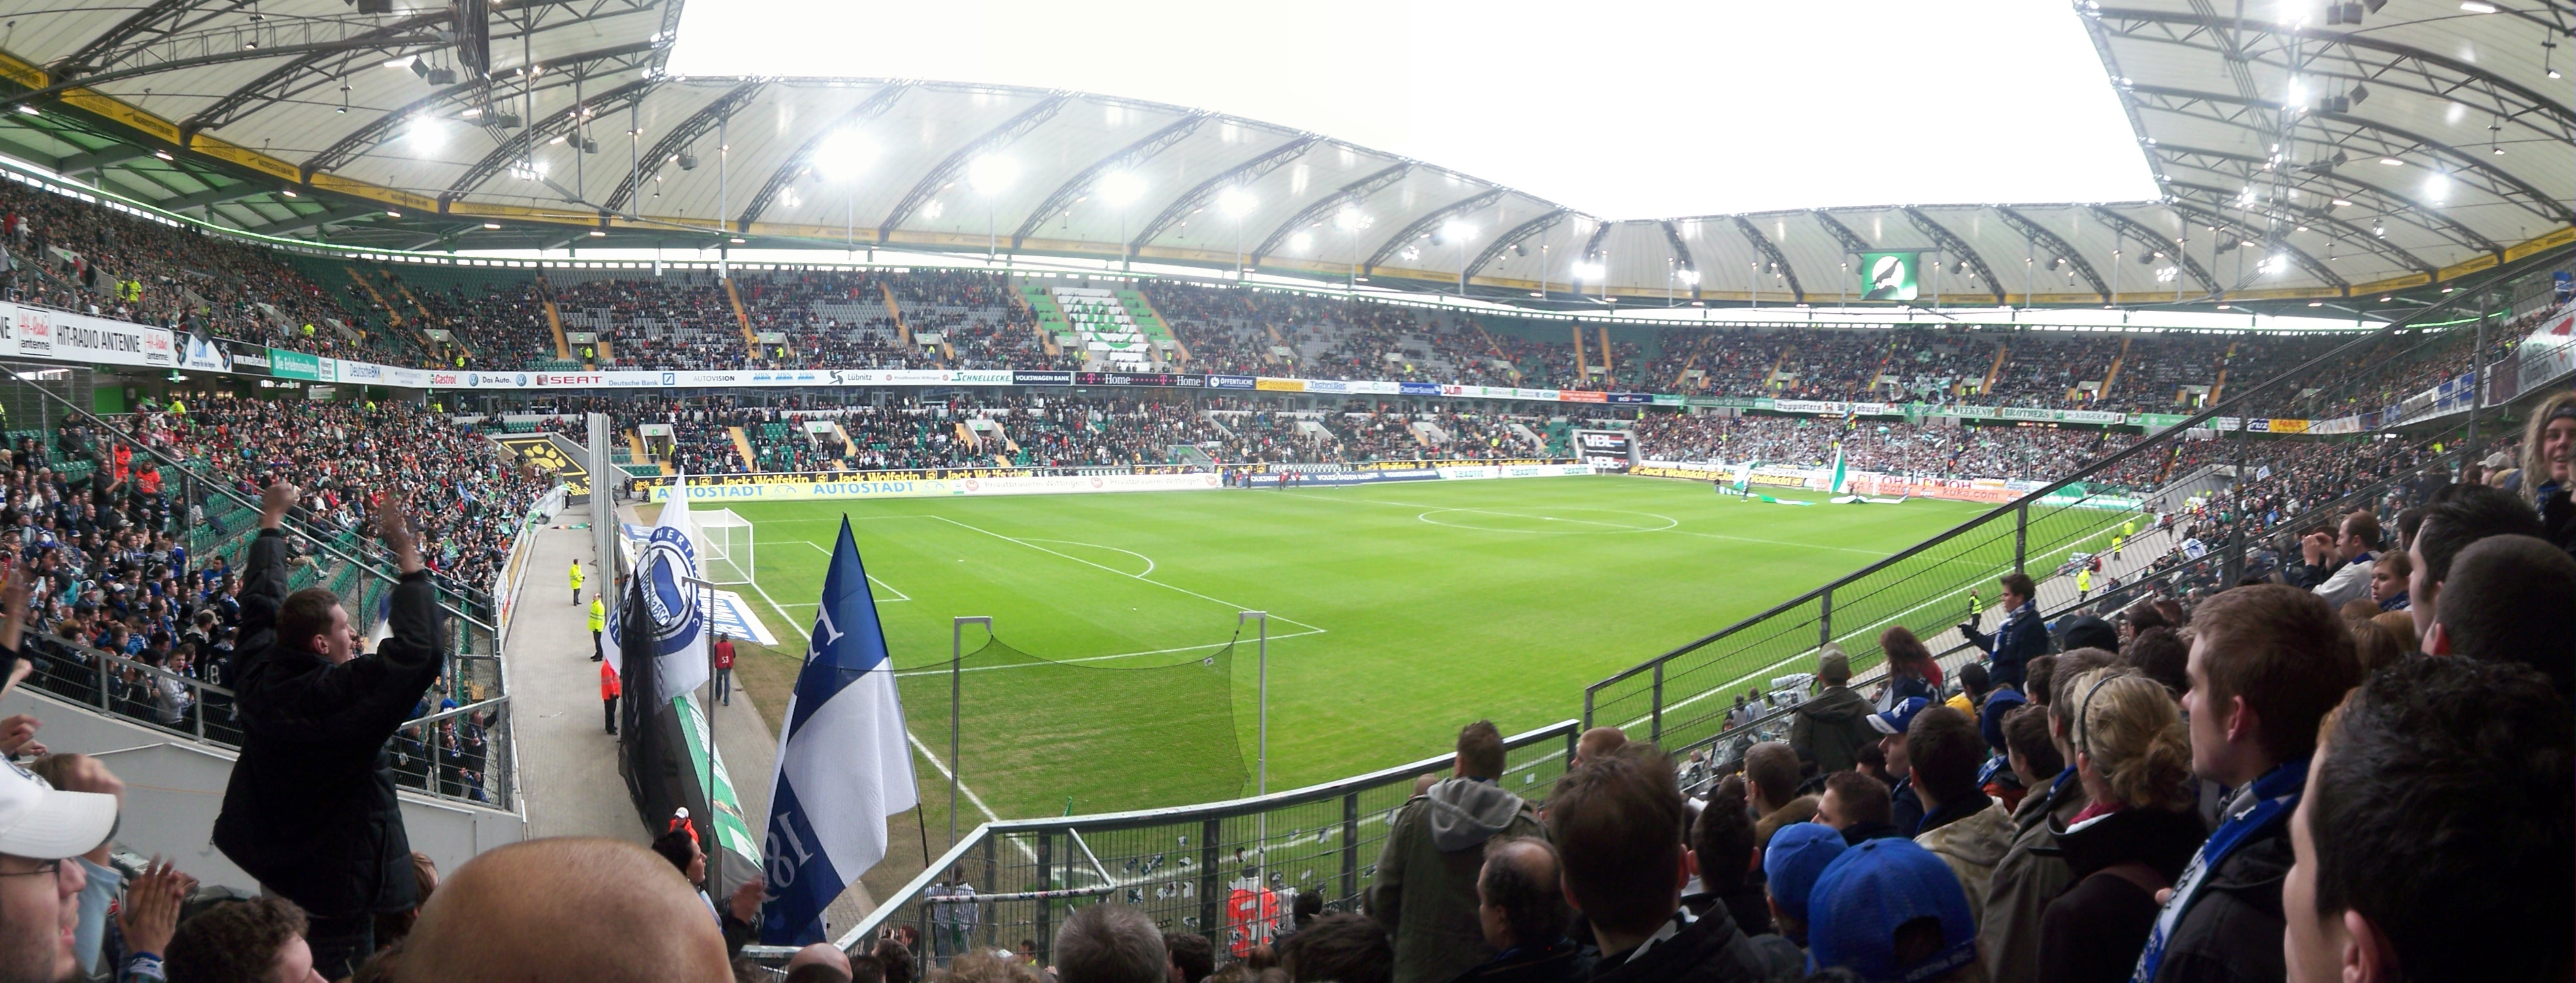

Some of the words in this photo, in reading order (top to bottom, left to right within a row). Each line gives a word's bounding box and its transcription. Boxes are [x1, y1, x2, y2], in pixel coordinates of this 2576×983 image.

[56, 324, 98, 349] HIT-RADIO
[101, 330, 141, 353] ANTENNE
[21, 338, 50, 351] antenne
[146, 351, 169, 361] antenne
[435, 374, 457, 384] Castrol
[551, 376, 603, 384] SEAT
[951, 372, 1011, 382] SCHNELLECKE
[1105, 373, 1131, 384] Home
[1176, 375, 1200, 386] Home
[1221, 376, 1253, 385] ÖFFENTLICHE
[834, 472, 865, 482] Jack
[867, 470, 921, 481] Wolfskin
[1640, 467, 1664, 476] Jack
[719, 476, 751, 486] Jack
[753, 474, 810, 485] Wolfskin
[657, 486, 764, 499] ATOSTADT
[813, 482, 914, 494] AUTOSTADT
[1942, 488, 1999, 499] kuka.com
